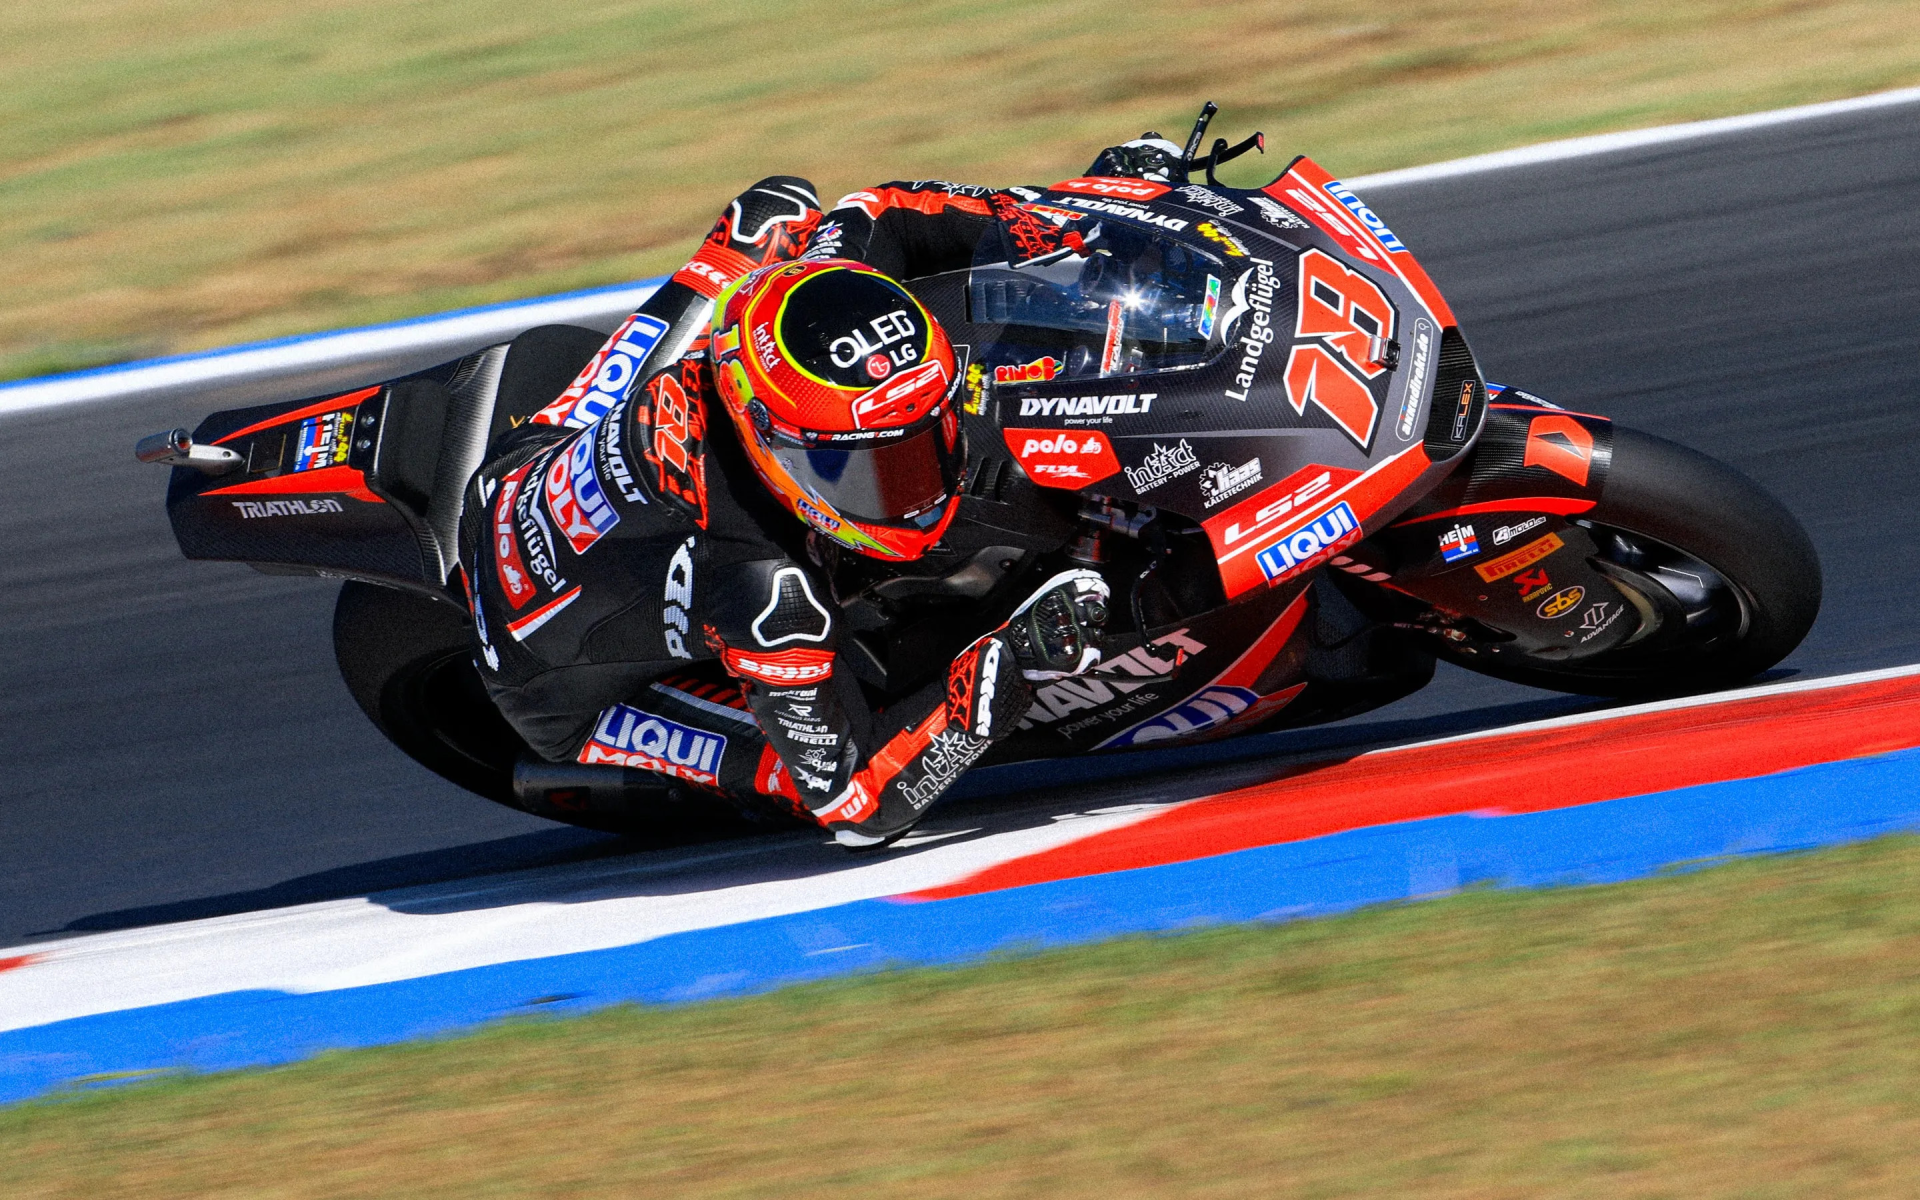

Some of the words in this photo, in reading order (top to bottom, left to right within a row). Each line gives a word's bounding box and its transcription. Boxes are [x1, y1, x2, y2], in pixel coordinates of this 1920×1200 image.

[1092, 183, 1155, 196] polo
[1052, 197, 1189, 231] DYNAVOLT
[1328, 182, 1405, 248] LIQUI
[829, 310, 916, 369] OLED
[1226, 257, 1281, 402] Landgeflügel
[891, 343, 917, 367] LG
[858, 363, 940, 415] LS2
[1019, 393, 1158, 416] DYNAVOLT
[1064, 418, 1085, 426] power
[1086, 418, 1102, 426] your
[1102, 416, 1113, 424] life
[607, 402, 648, 504] NAVOLT
[1021, 434, 1077, 458] polo
[1034, 464, 1079, 474] FLM
[550, 453, 597, 539] OLY
[569, 431, 613, 529] QUI
[1136, 477, 1168, 495] BATTERY
[1173, 461, 1201, 479] POWER
[1203, 473, 1264, 509] KÄLTETECHNIK
[1216, 457, 1262, 494] haas
[498, 481, 518, 558] polo
[517, 450, 566, 593] andgeflügel
[1225, 471, 1332, 545] LS2
[1262, 506, 1354, 577] LIQUI
[1484, 538, 1555, 578] PIRELLI
[1580, 604, 1625, 643] ADVANTAGE
[1018, 628, 1208, 730] NAVOLT
[594, 706, 718, 771] LIQUI
[1056, 714, 1100, 740] power
[1103, 702, 1133, 721] your
[1135, 692, 1159, 708] life
[913, 772, 957, 810] BATTERY
